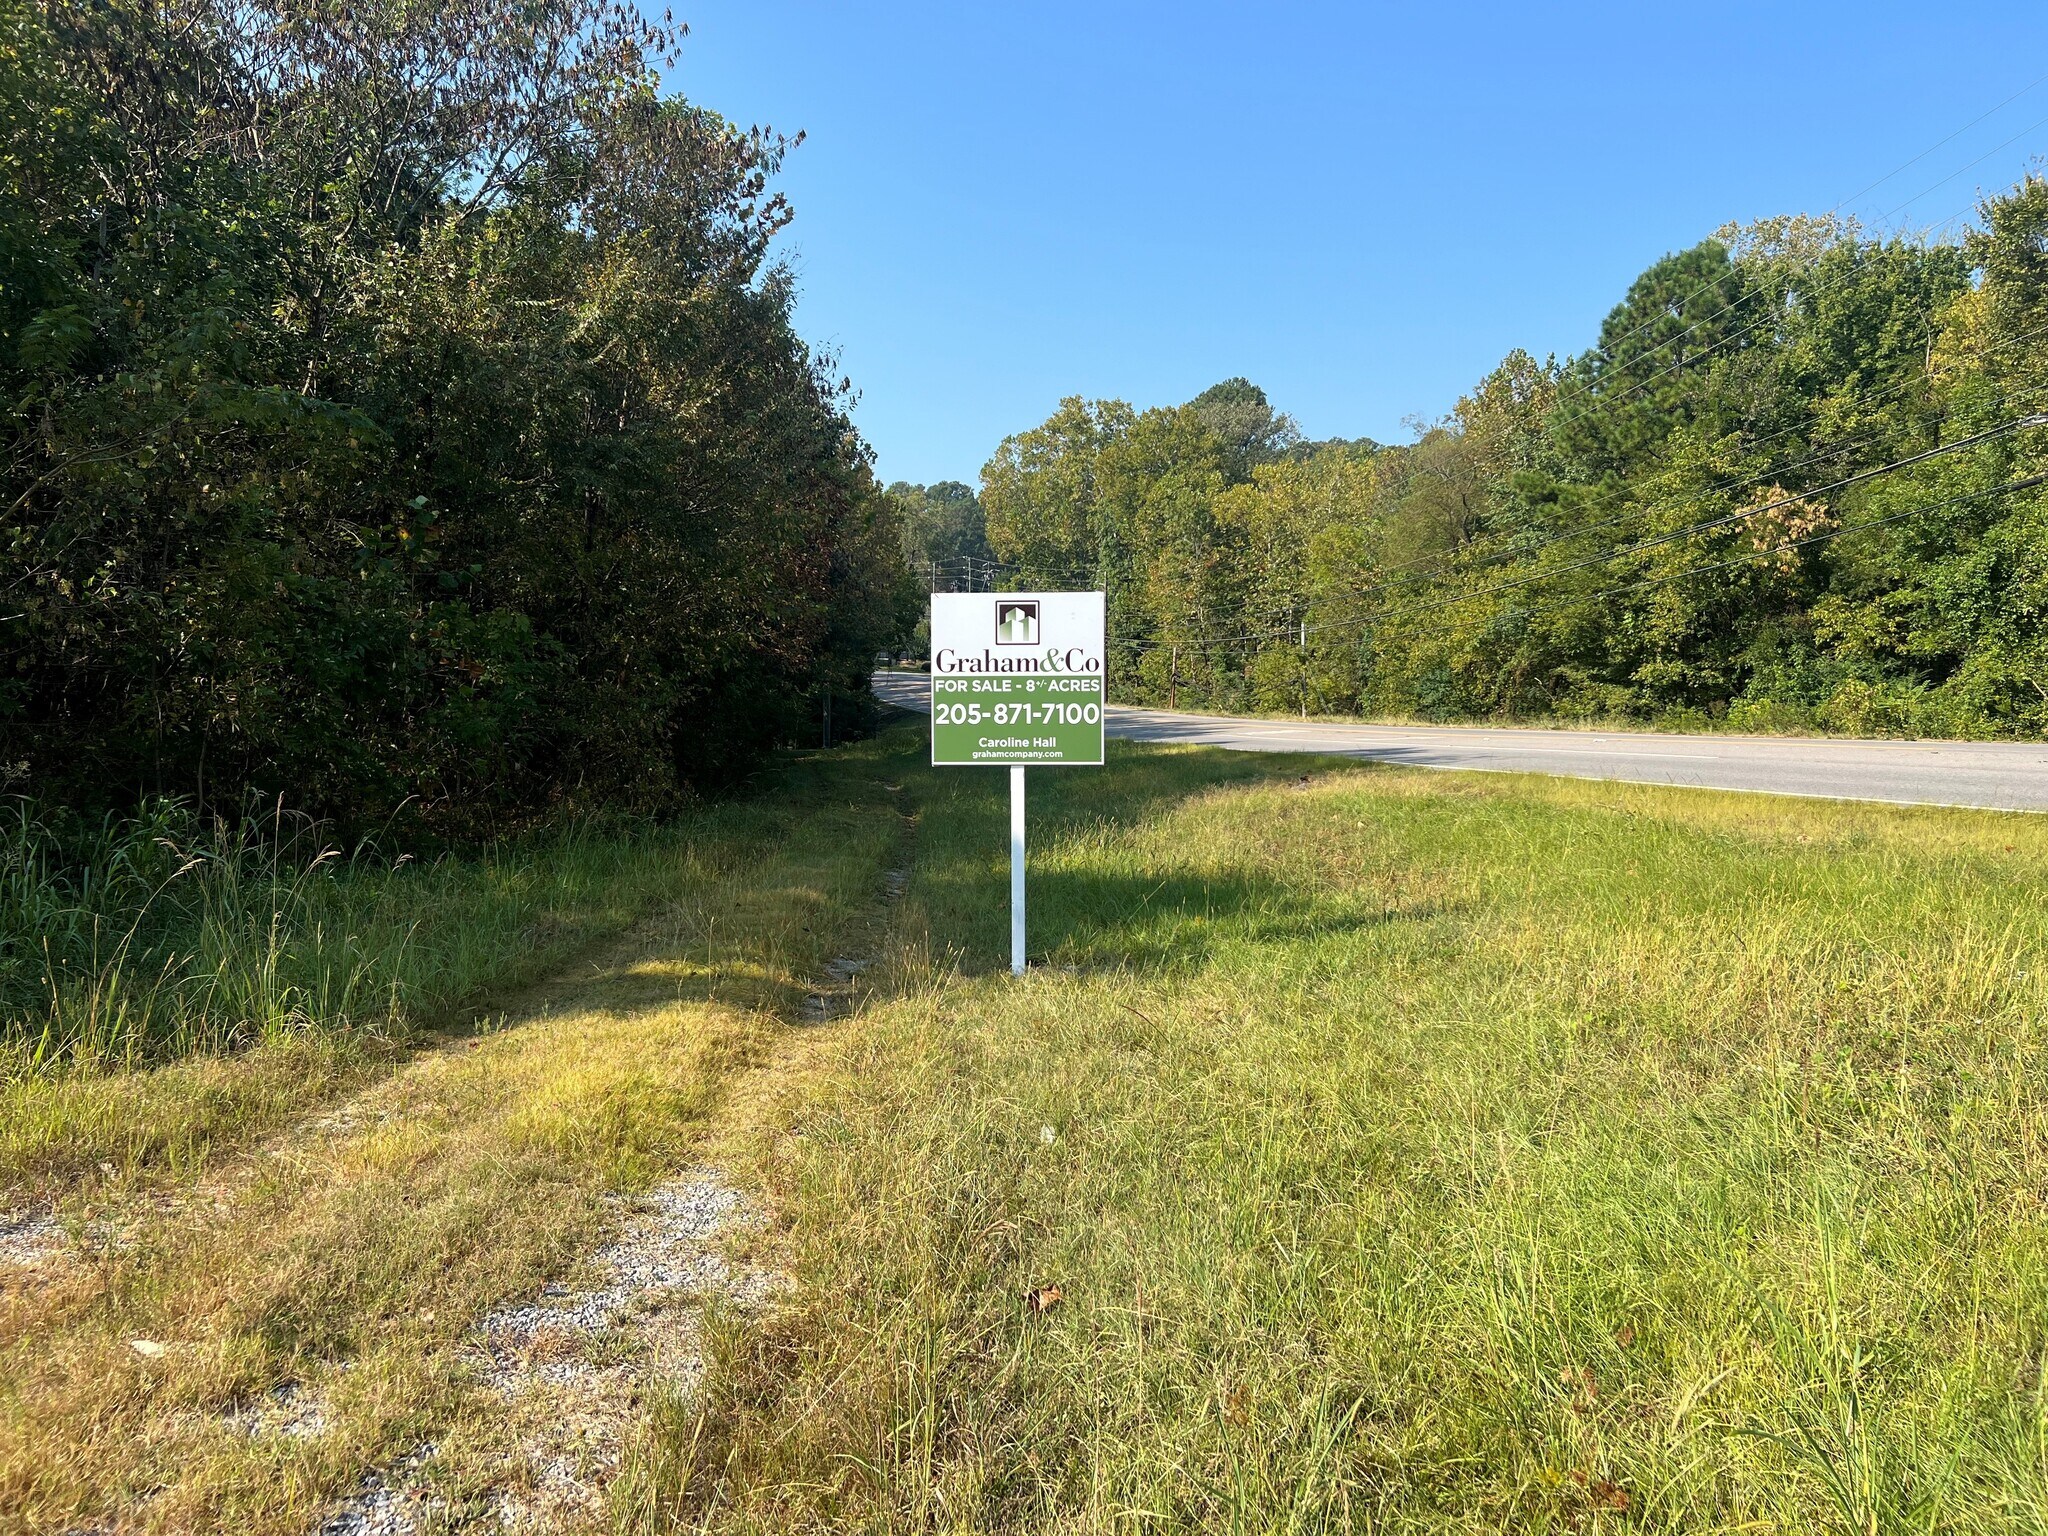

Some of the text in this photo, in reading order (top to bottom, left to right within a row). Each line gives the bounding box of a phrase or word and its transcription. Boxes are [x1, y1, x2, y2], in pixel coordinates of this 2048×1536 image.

[936, 648, 1099, 672] Graham&Co
[935, 680, 967, 692] FOR
[972, 680, 1011, 692] SALE
[1048, 680, 1099, 692] ACRES
[936, 703, 1099, 725] 205-871-7100
[979, 738, 1056, 747] Caroline Hall
